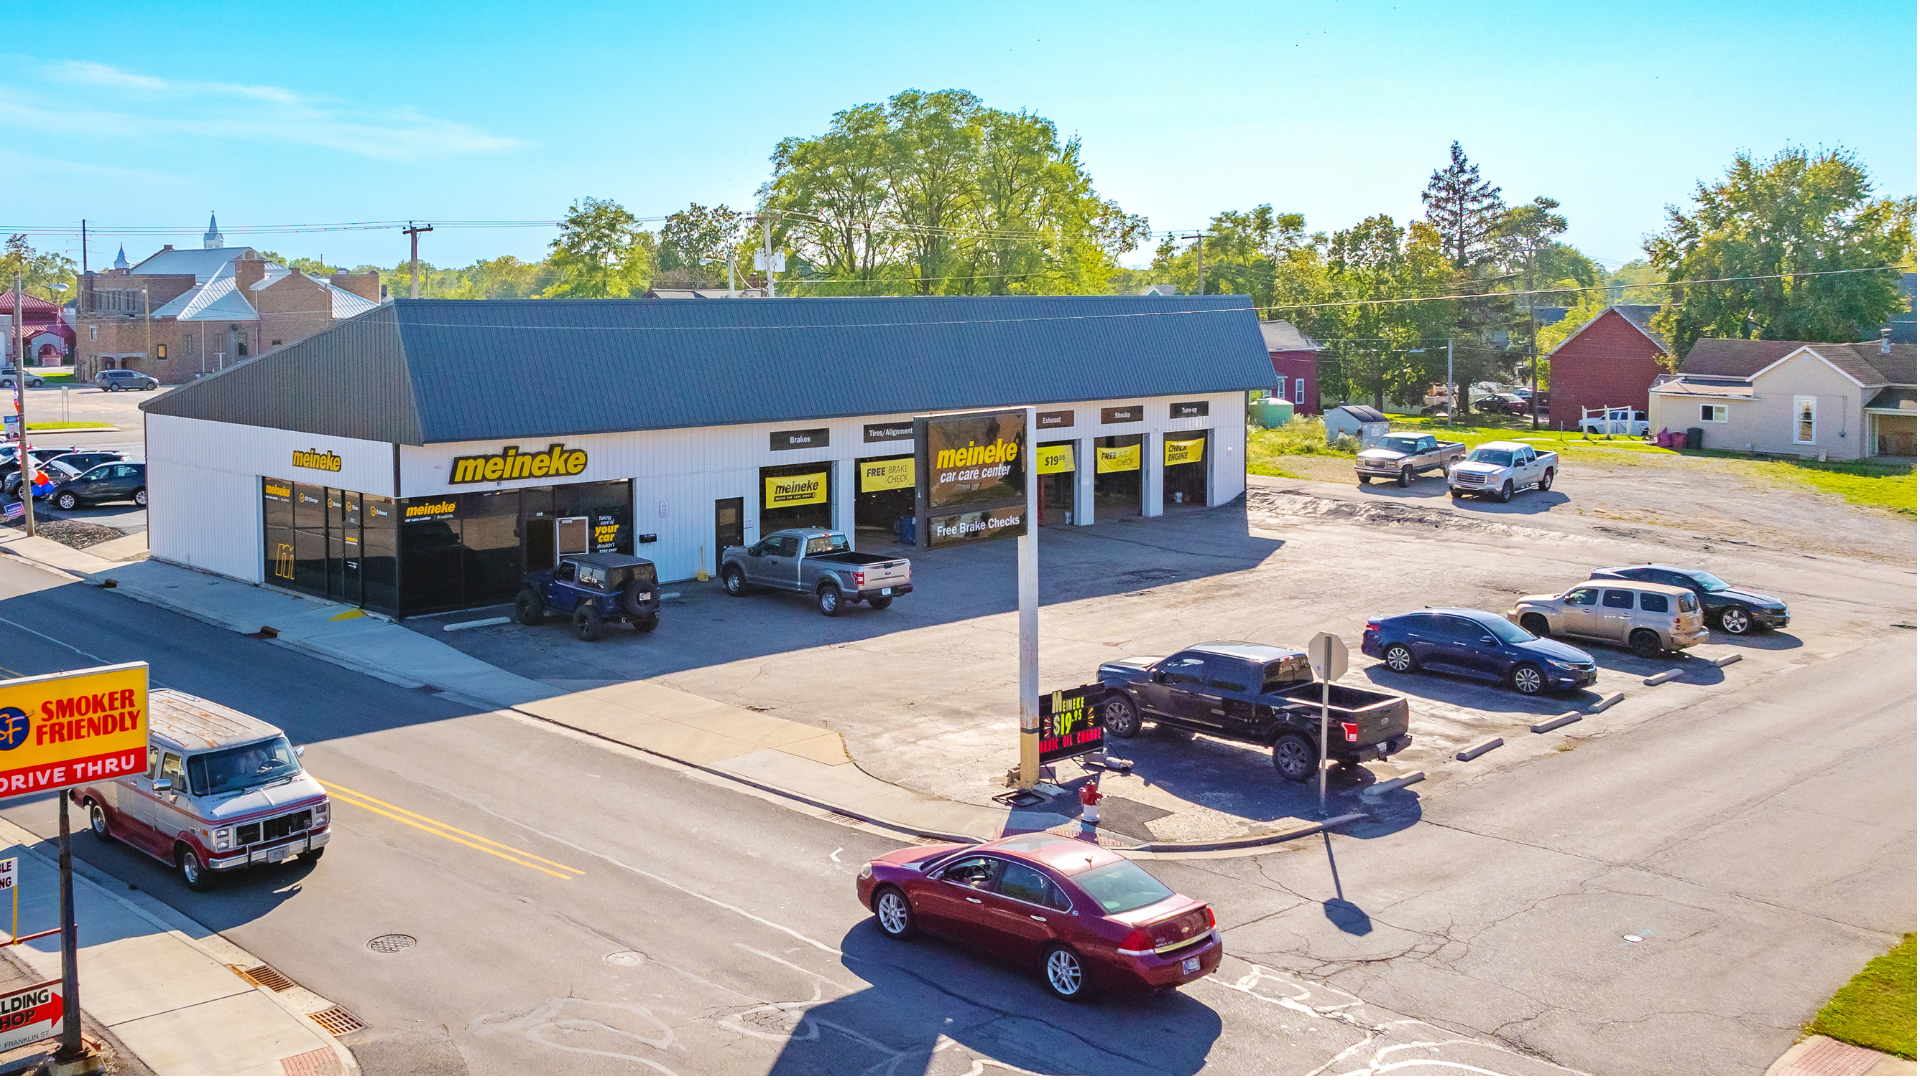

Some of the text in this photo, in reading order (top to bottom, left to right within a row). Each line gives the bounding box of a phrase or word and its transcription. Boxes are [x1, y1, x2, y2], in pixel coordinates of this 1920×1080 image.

[1042, 416, 1061, 424] Exhaust
[868, 427, 914, 437] Tires/Alignment
[790, 436, 811, 444] Brakes
[293, 448, 341, 472] meineke
[937, 438, 1018, 469] meineke
[1100, 452, 1117, 460] FREE
[1168, 452, 1188, 462] ENGINE
[454, 447, 586, 482] meineke
[1116, 458, 1133, 466] CHECK
[866, 464, 908, 478] FREE BRAKE
[940, 464, 1011, 483] car care center
[887, 474, 908, 484] CHECK
[265, 484, 290, 498] meineke
[775, 480, 819, 495] meineke
[406, 501, 456, 517] meineke
[594, 524, 620, 537] your
[937, 516, 1020, 537] Free Brake Checks
[598, 534, 616, 542] car
[41, 688, 136, 722] SMOKER
[36, 710, 141, 746] FRIENDLY
[1062, 734, 1072, 747] OIL
[1076, 726, 1102, 744] CHANGE
[0, 754, 135, 793] DRIVE THRU
[0, 861, 12, 874] LE
[0, 989, 49, 1014] LDING
[4, 1034, 39, 1049] FRANKLIN
[40, 1030, 50, 1038] ST.
